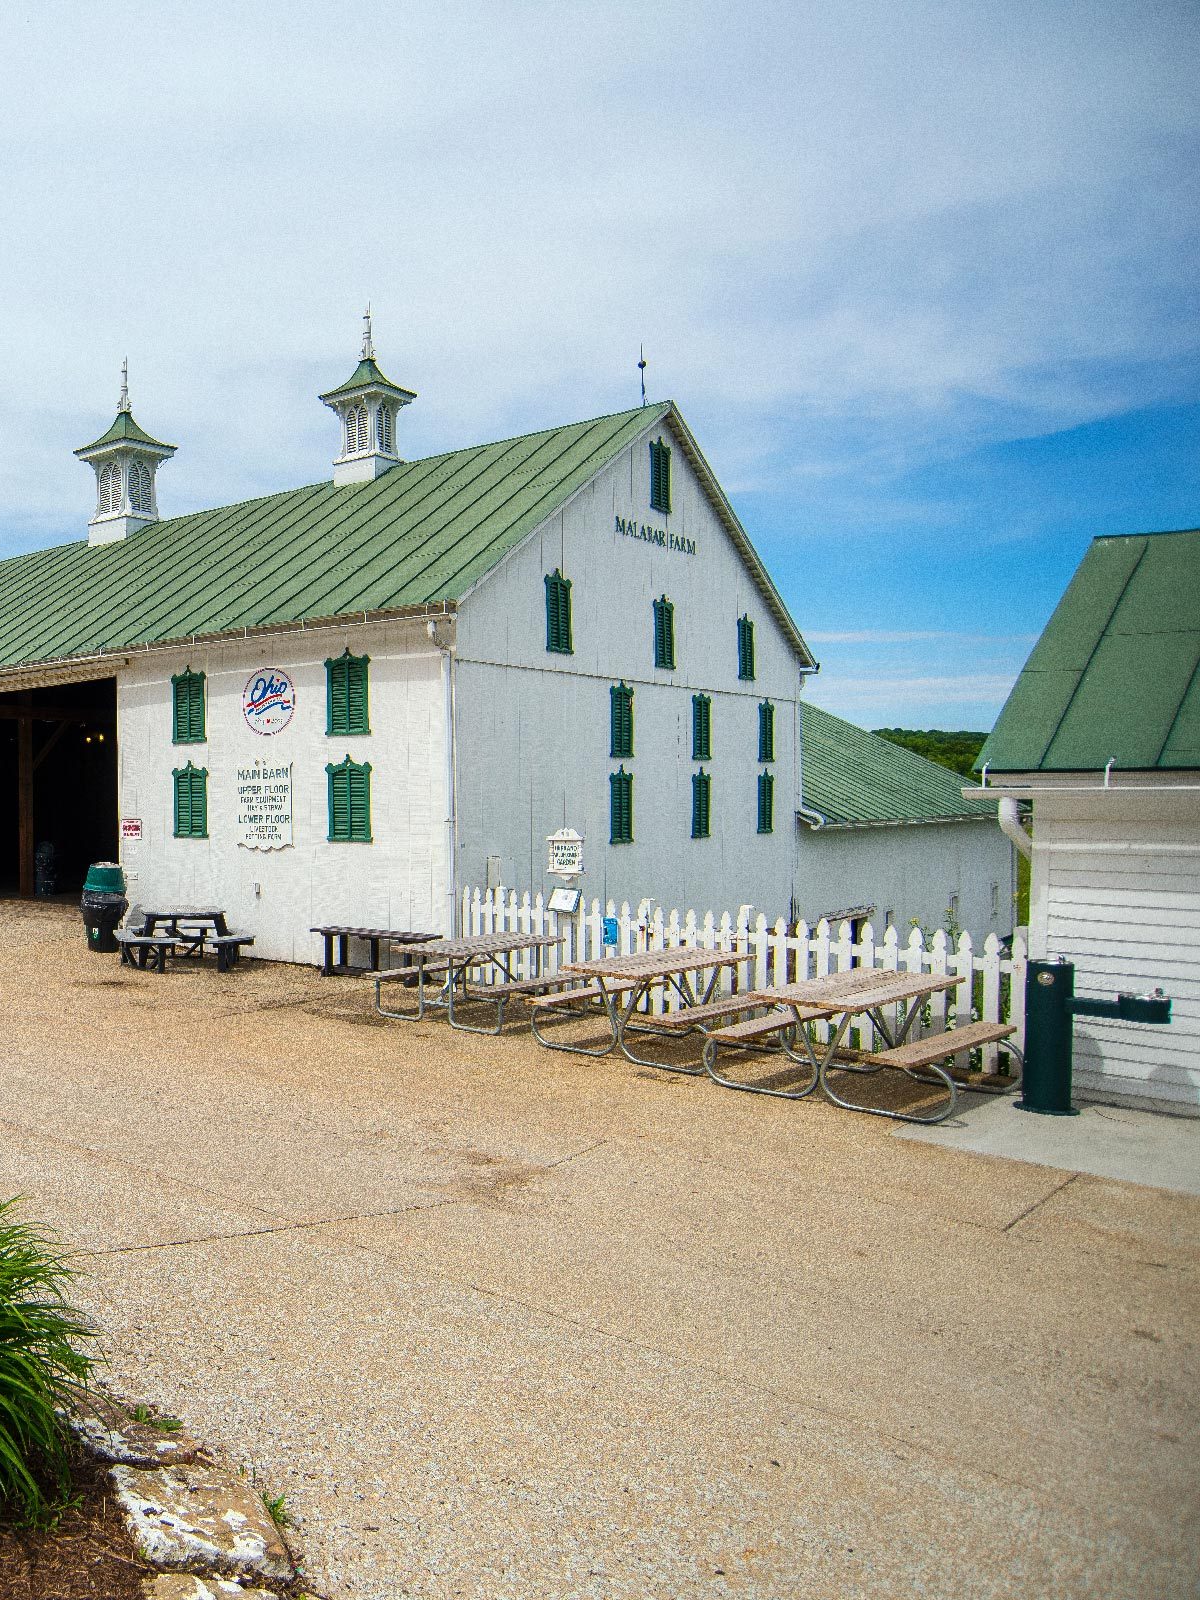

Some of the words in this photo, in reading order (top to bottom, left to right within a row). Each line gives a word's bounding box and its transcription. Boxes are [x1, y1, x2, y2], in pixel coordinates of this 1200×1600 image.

[615, 515, 667, 547] MALABAR
[669, 533, 696, 555] FARM
[251, 675, 288, 703] Ohio
[237, 769, 261, 780] MAIN
[262, 767, 289, 780] BARN
[238, 785, 262, 795] UPPER
[264, 784, 289, 794] FLOOR
[255, 795, 287, 804] EQUIPMENT
[264, 804, 283, 812] STRAW
[238, 814, 264, 824] LOWER
[265, 814, 290, 824] FLOOR
